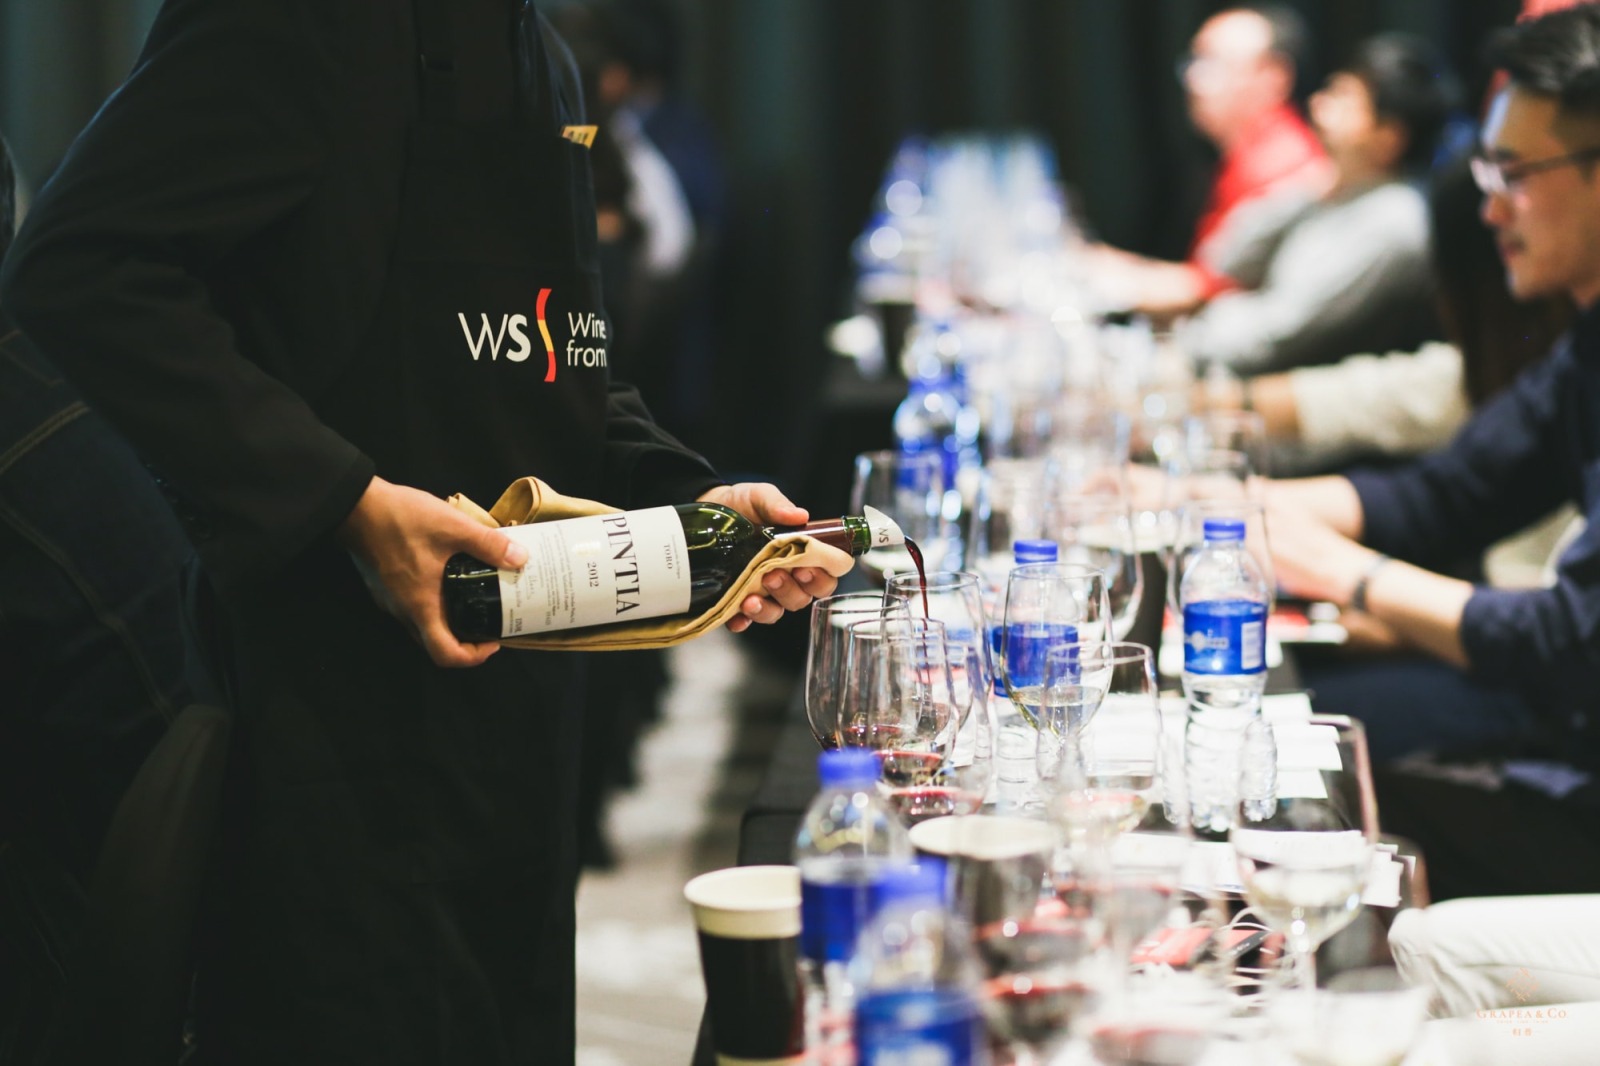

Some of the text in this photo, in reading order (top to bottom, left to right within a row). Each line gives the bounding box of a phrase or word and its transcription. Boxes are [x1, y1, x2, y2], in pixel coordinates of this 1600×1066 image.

[457, 312, 532, 363] WS
[566, 338, 608, 368] from
[601, 515, 641, 616] PINTIA
[663, 543, 674, 571] TORO
[586, 561, 600, 588] 2012
